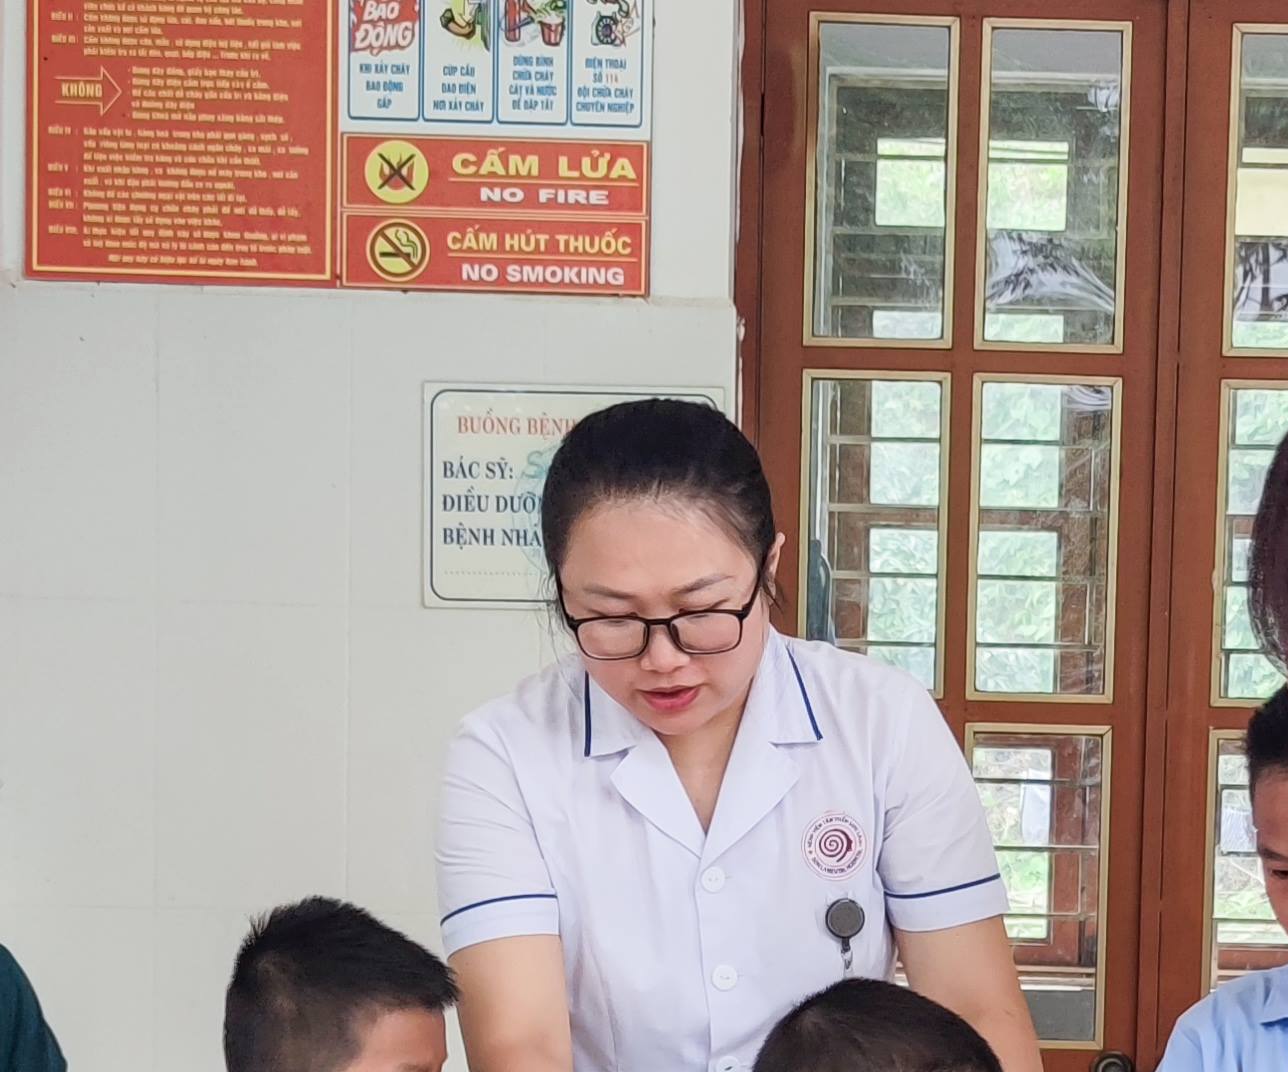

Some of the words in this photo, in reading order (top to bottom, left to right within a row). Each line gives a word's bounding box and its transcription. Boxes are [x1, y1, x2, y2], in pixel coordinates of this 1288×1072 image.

[61, 80, 103, 98] KHÔNG
[451, 147, 539, 177] CẤM
[558, 149, 637, 179] LỬA
[480, 187, 524, 202] NO
[538, 188, 609, 205] FIRE
[447, 224, 498, 251] CẤM
[505, 229, 549, 252] HÚT
[555, 228, 632, 255] THUỐC
[462, 263, 499, 282] NO
[506, 264, 625, 285] SMOKING
[457, 407, 521, 435] BUỒNG
[442, 455, 481, 479] BÁC
[485, 456, 514, 480] SỸ:
[442, 486, 490, 513] ĐIỀU
[442, 522, 495, 550] BỆNH
